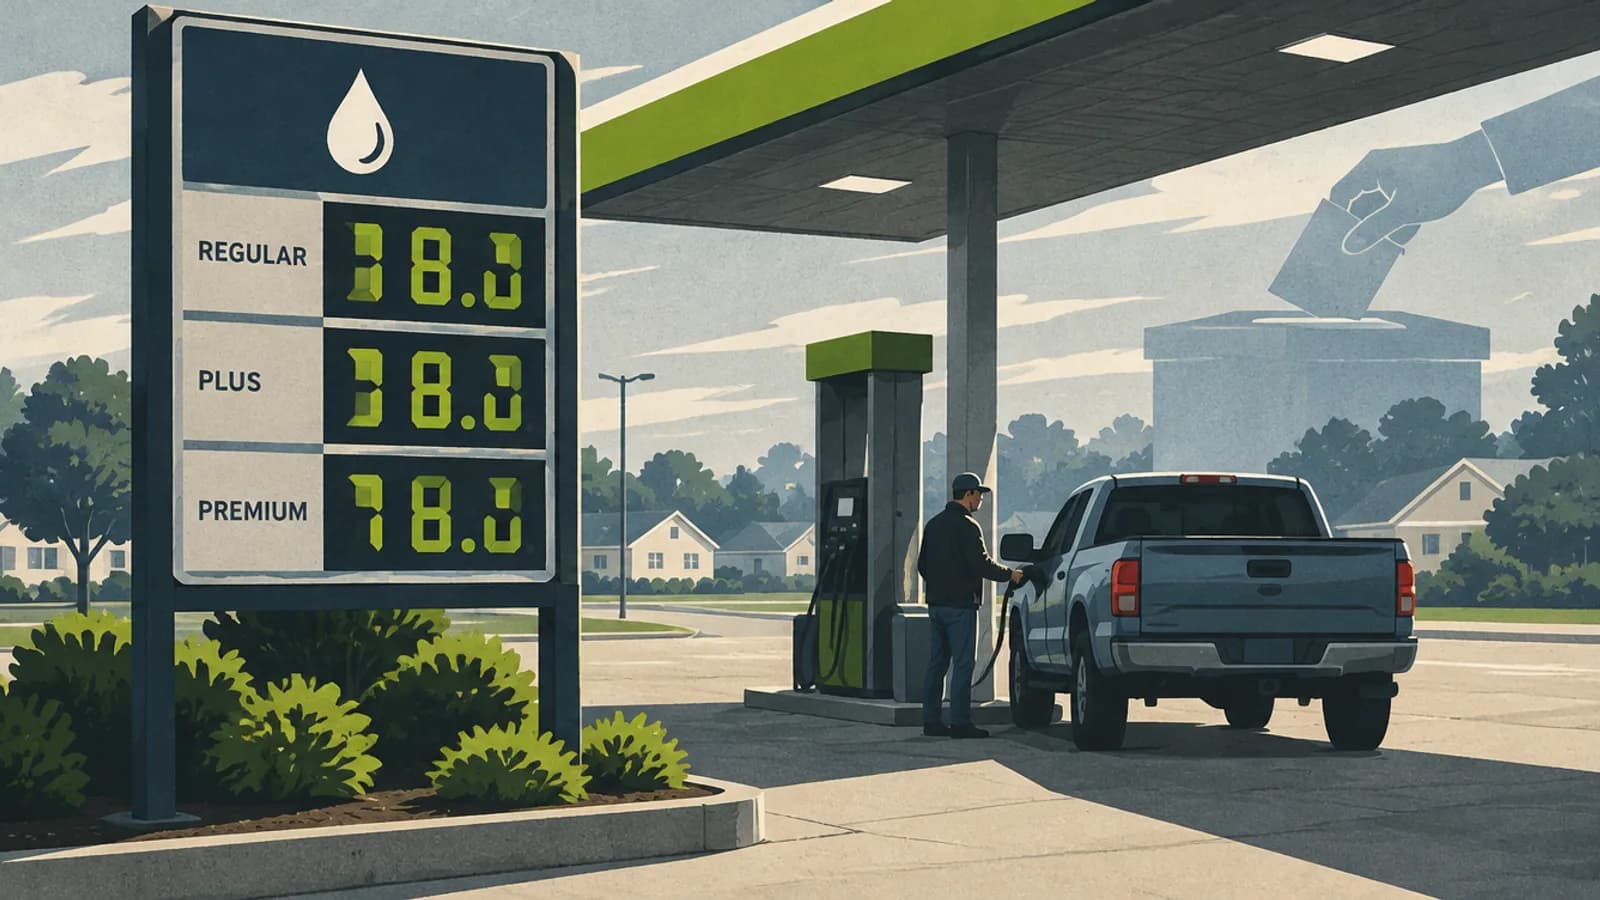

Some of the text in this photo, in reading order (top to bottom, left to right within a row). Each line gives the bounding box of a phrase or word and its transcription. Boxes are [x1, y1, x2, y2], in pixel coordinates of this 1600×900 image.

[199, 241, 307, 267] REGULAR
[200, 369, 262, 392] PLUS
[199, 499, 308, 522] PREMIUM
